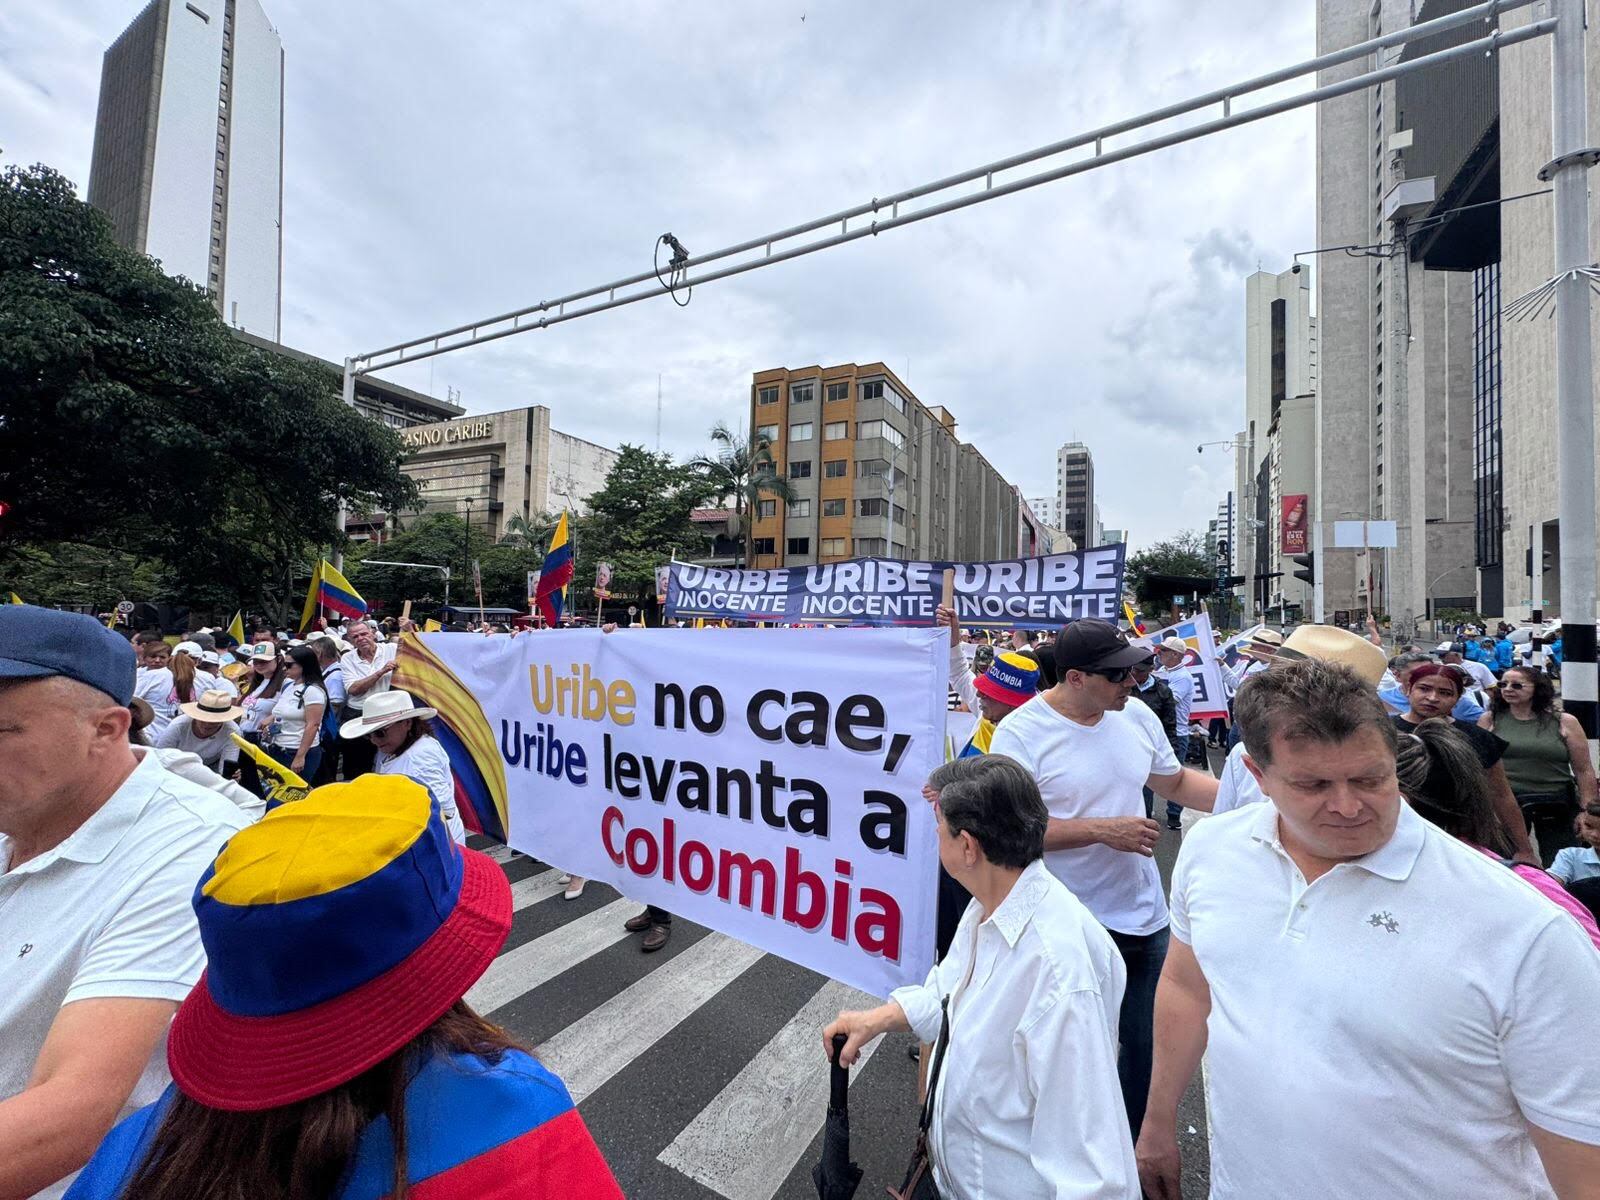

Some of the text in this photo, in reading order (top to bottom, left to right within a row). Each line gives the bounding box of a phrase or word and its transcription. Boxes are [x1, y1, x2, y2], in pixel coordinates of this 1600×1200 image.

[444, 422, 491, 442] CARIBE
[679, 566, 790, 592] URIBE
[805, 562, 932, 593] URIBE
[952, 550, 1117, 593] URIBE
[677, 591, 787, 612] INOCENTE
[802, 595, 933, 616] INOCENTE
[953, 593, 1116, 618] INOCENTE
[990, 666, 1022, 688] COLOMBIA
[530, 664, 911, 773] Uribe no cae,
[502, 719, 908, 855] Uribe levanta a
[601, 806, 900, 961] Colombia
